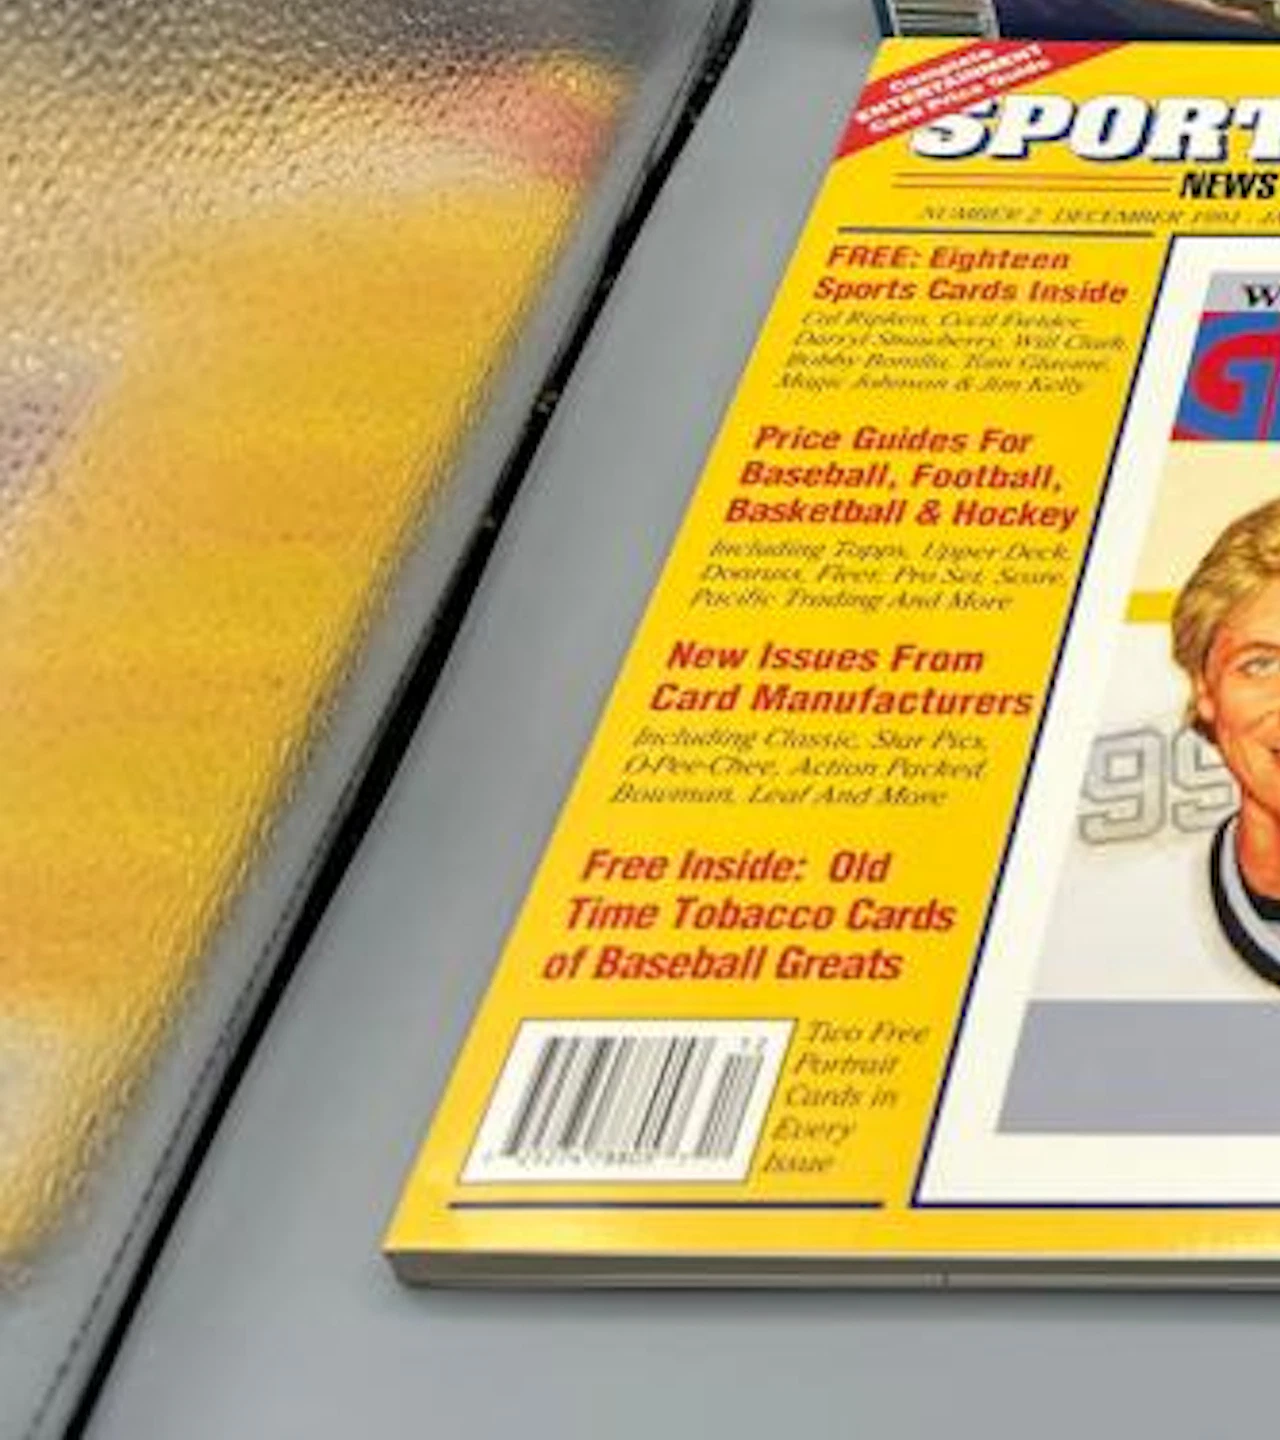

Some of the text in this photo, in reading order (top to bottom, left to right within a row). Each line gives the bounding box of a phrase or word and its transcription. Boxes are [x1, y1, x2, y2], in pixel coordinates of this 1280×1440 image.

[855, 42, 1045, 125] ENTERTAINMENT
[1179, 173, 1279, 200] NEWS
[826, 244, 1070, 272] FREE: Eighteen
[812, 276, 1129, 304] Sports Cards Inside
[753, 424, 1035, 454] Price Guides For
[740, 460, 1062, 492] Baseball, Football,
[725, 497, 1079, 532] Basketball & Hockey
[666, 640, 984, 674] New Issues From
[649, 683, 1036, 717] Card Manufacturers
[579, 849, 892, 884] Free Inside: Old
[564, 897, 958, 932] Time Tobacco Cards
[542, 946, 904, 981] of Baseball Greats
